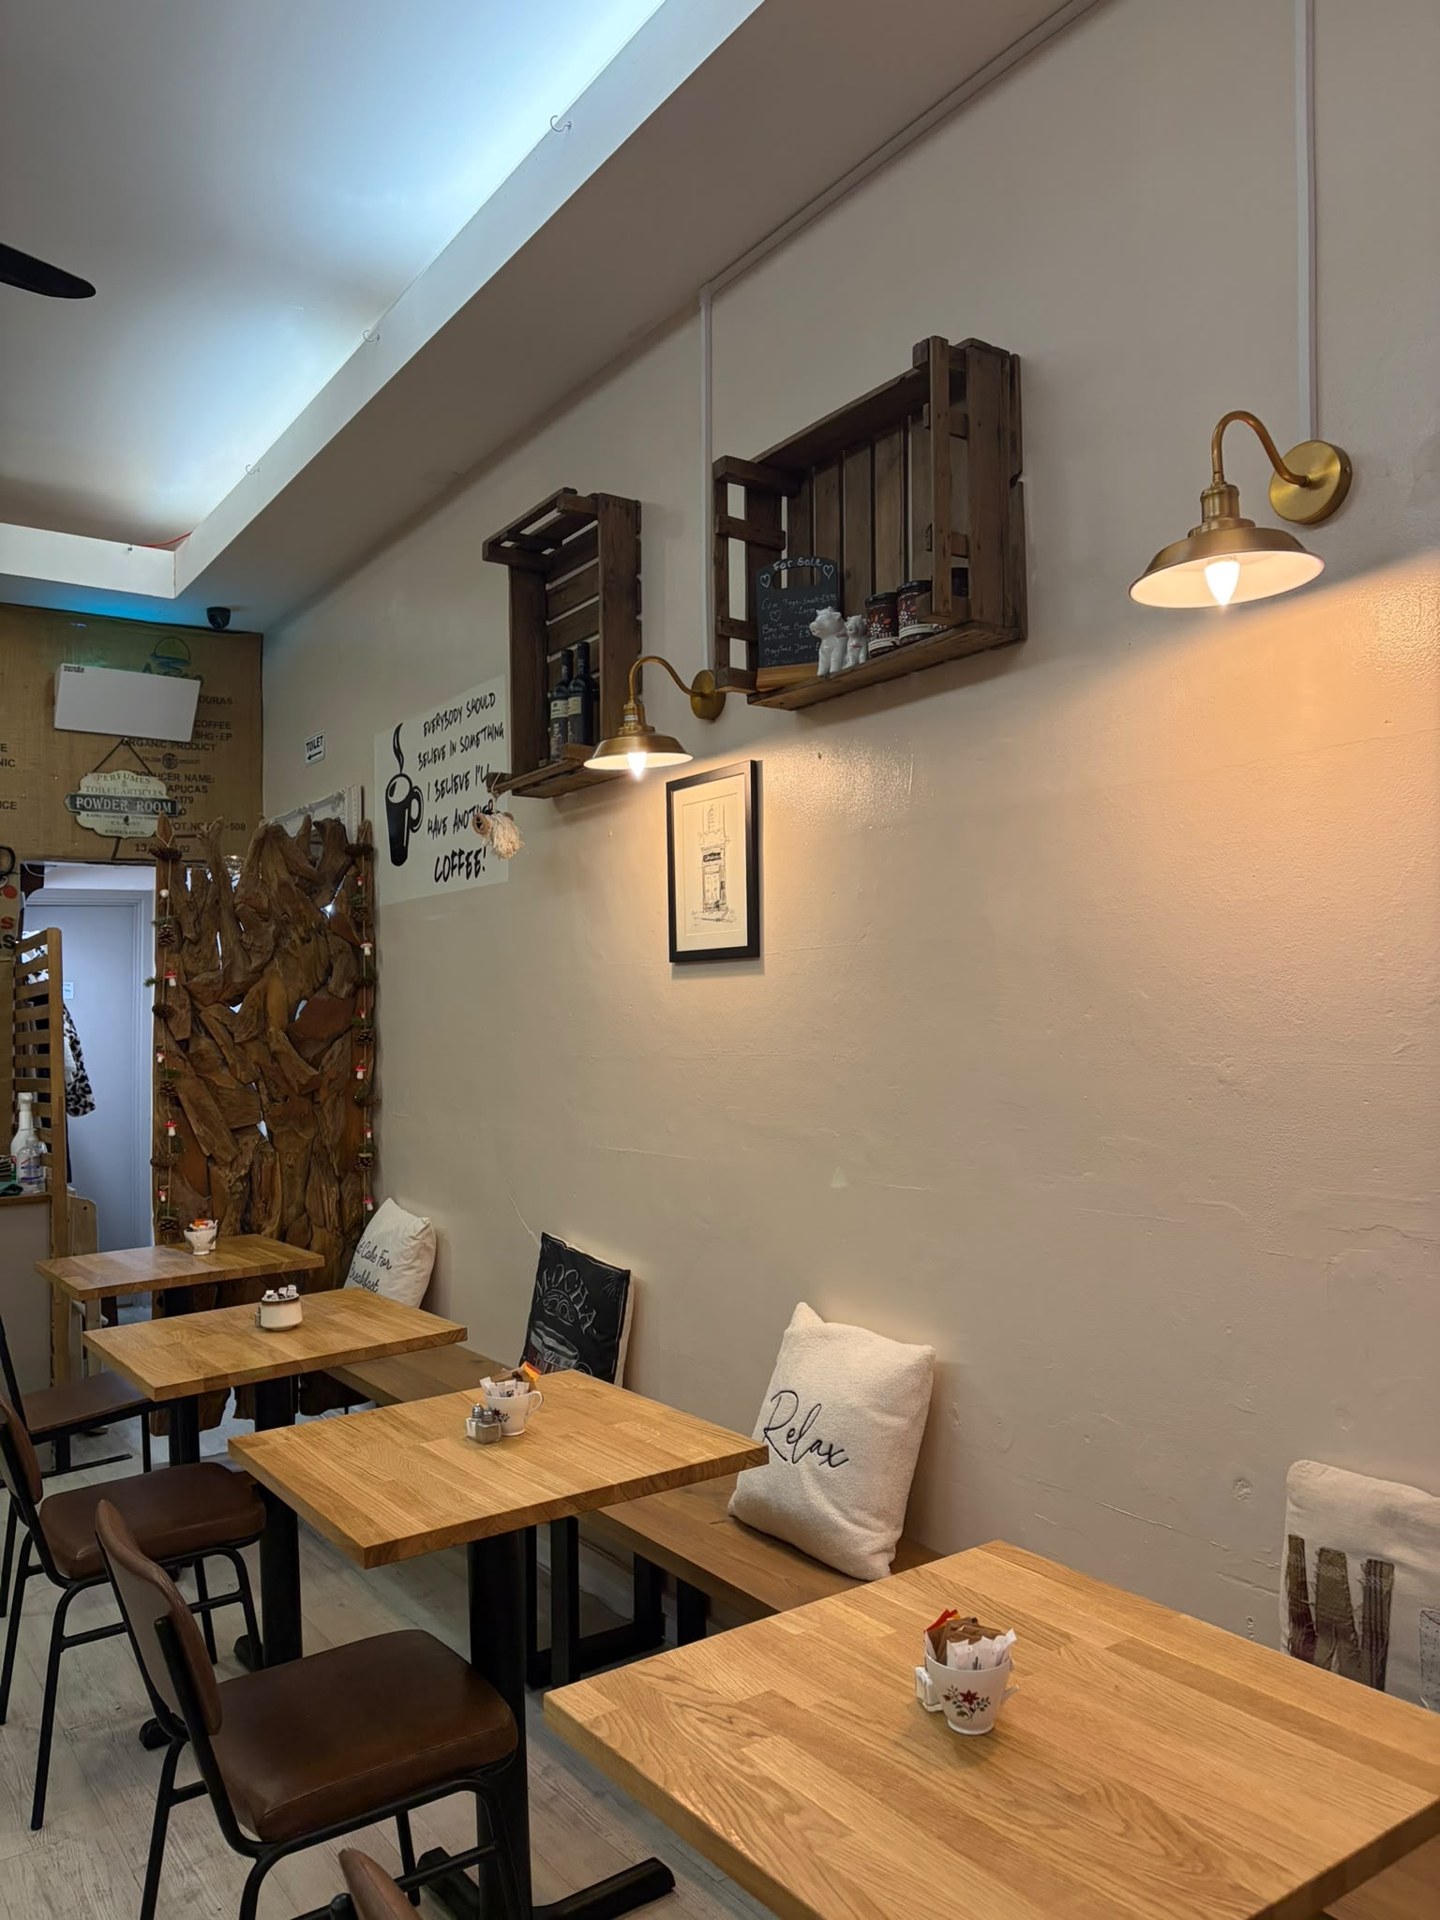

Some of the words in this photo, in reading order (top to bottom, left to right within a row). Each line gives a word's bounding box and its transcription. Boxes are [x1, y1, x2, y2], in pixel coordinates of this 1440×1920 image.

[773, 560, 794, 571] For
[797, 557, 823, 567] Sale
[194, 720, 232, 730] COFFEE
[423, 706, 462, 737] EVERYBODY
[466, 692, 496, 718] SHOULD
[171, 742, 216, 751] PRODUCT
[306, 735, 323, 753] TOILET
[418, 744, 446, 771] BELIEVE
[450, 740, 457, 757] IN
[459, 722, 504, 753] SOMETHING
[97, 773, 151, 785] PERFUMES
[427, 781, 431, 801] I
[434, 770, 470, 803] BELIEVE
[85, 785, 118, 795] TOILET
[120, 787, 164, 796] ARTICLES
[75, 797, 128, 811] POWDER
[136, 801, 172, 813] ROOM
[427, 816, 448, 840] HAVE
[434, 846, 487, 883] COFFEE!
[361, 1241, 378, 1263] Cake
[377, 1249, 392, 1270] For
[762, 1390, 849, 1468] Relax
